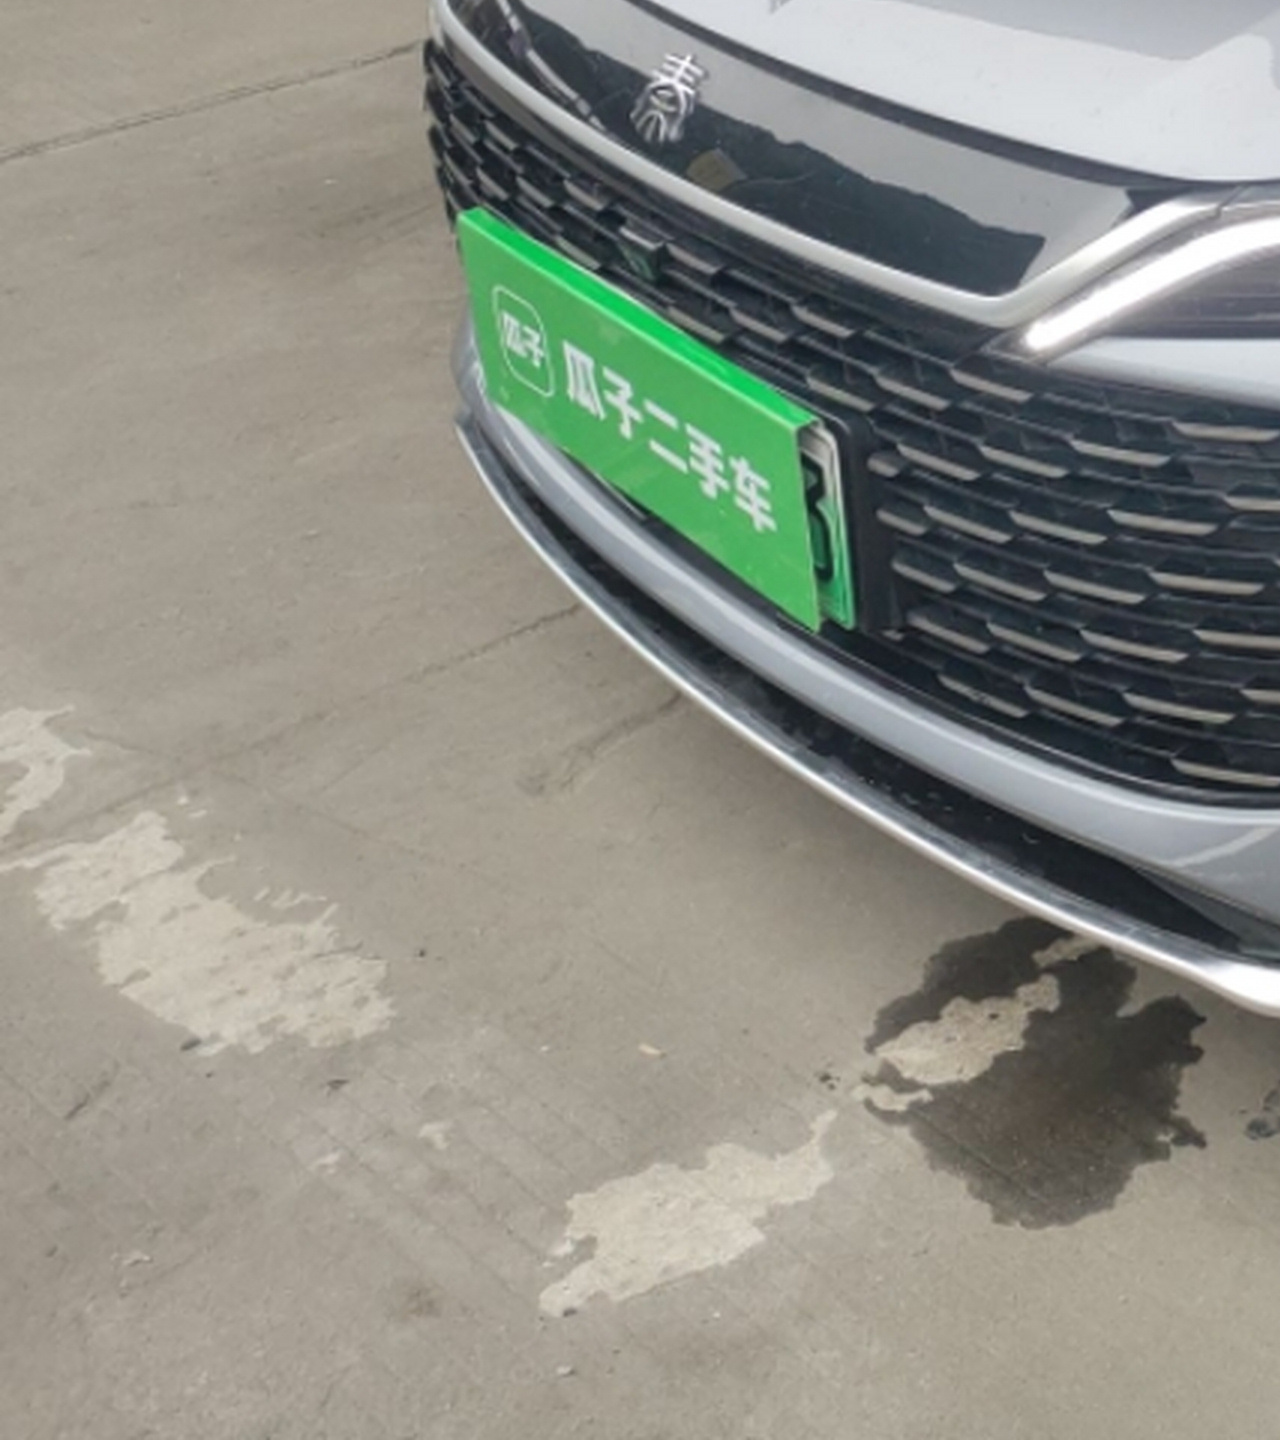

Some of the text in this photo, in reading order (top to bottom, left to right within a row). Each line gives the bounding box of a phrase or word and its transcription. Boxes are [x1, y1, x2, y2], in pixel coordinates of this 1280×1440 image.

[502, 311, 546, 368] 瓜子
[562, 340, 778, 533] 瓜子二手车
